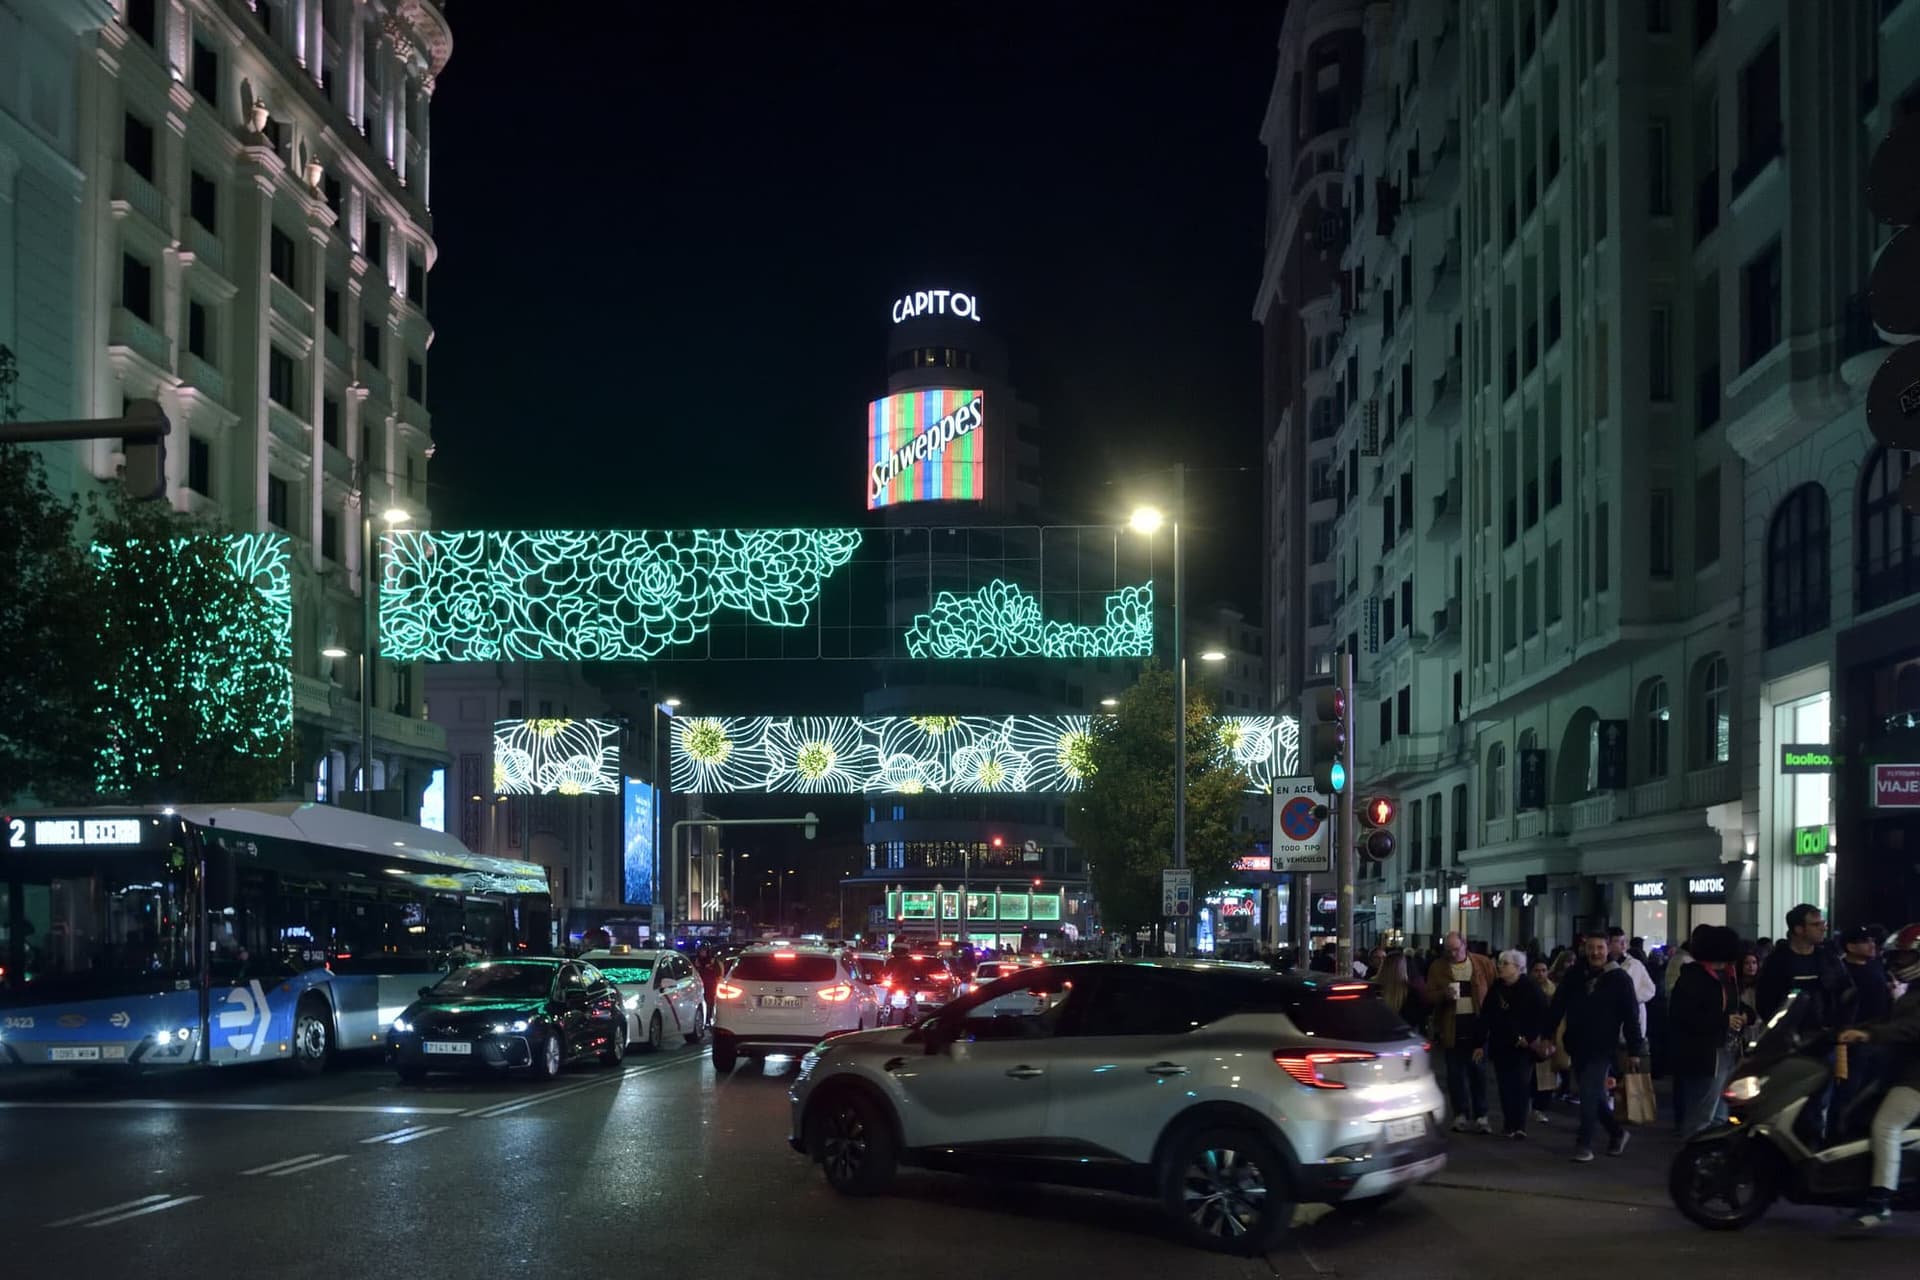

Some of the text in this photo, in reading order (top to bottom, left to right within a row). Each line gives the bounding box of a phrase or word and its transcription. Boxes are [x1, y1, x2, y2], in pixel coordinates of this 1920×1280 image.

[893, 290, 981, 323] CAPITOL
[872, 398, 981, 500] Schweppes
[10, 819, 26, 847] 2
[1689, 878, 1724, 893] PARFOIS
[5, 1017, 34, 1028] 3423
